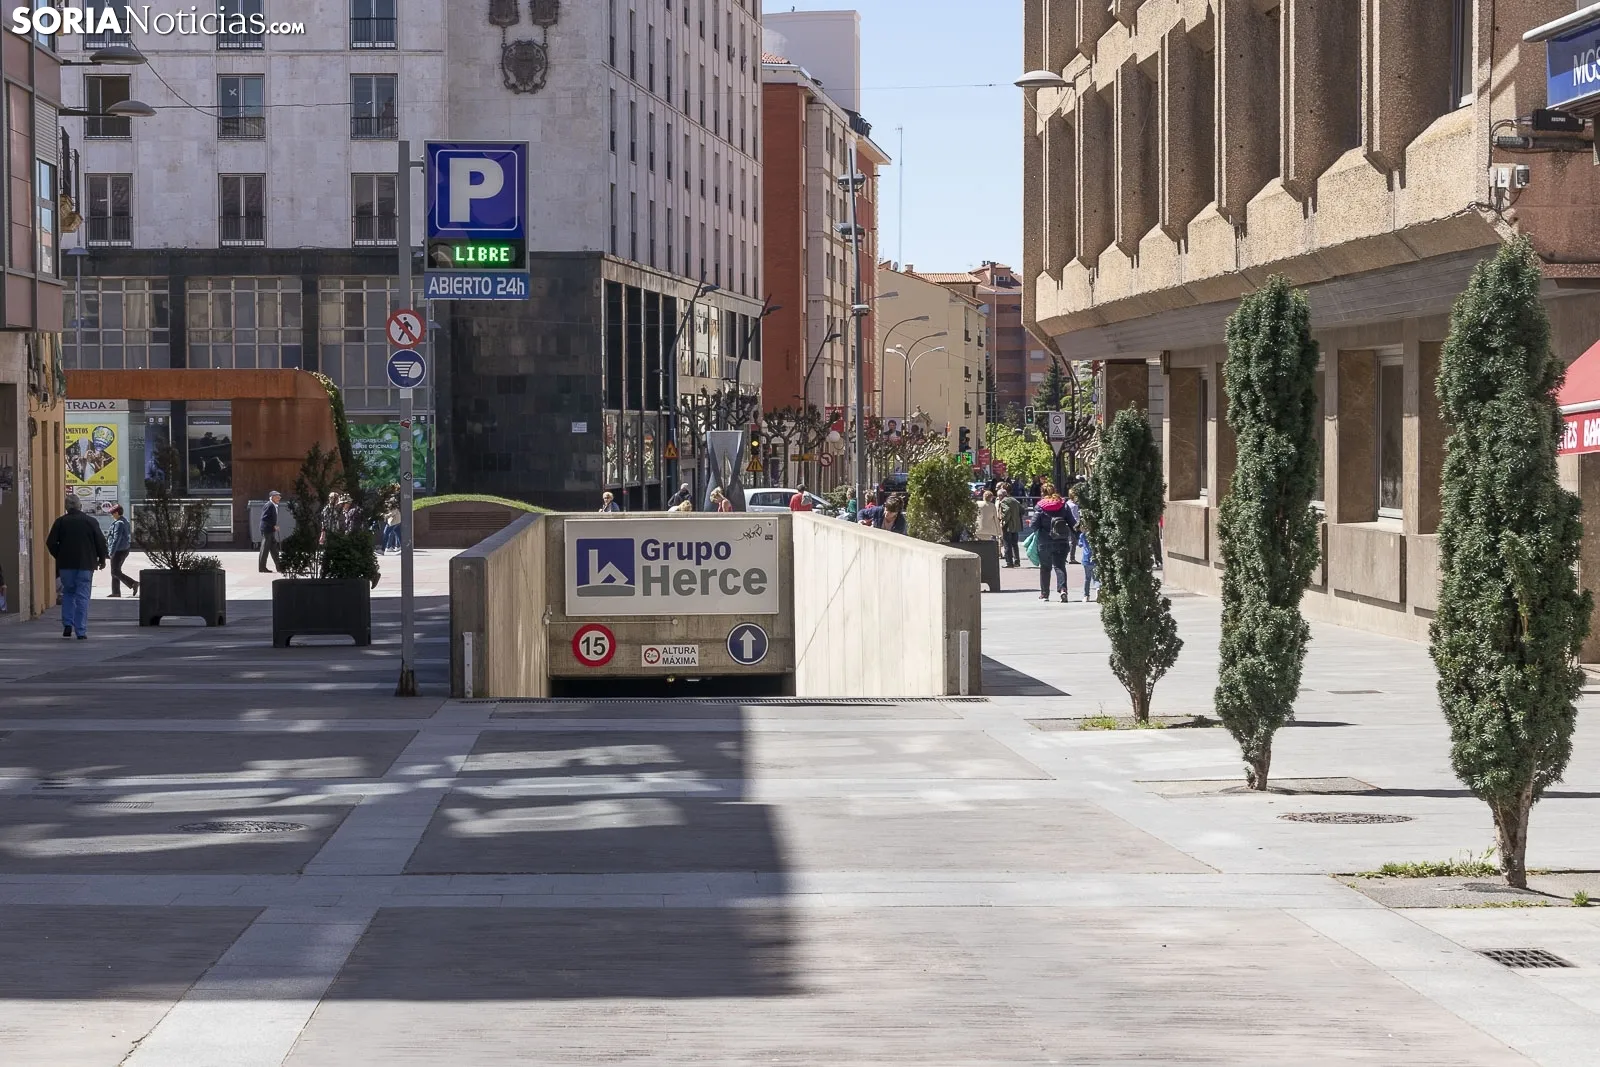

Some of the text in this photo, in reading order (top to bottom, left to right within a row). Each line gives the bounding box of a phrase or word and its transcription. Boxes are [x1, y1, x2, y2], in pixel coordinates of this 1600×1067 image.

[449, 157, 505, 223] P
[455, 246, 510, 262] LIBRE
[428, 276, 525, 295] ABIERTO 24h
[109, 401, 115, 409] 2
[640, 538, 732, 566] Grupo
[642, 565, 768, 597] Herce
[581, 636, 606, 656] 15
[661, 646, 697, 655] ALTURA
[661, 655, 697, 665] MÁXIMA
